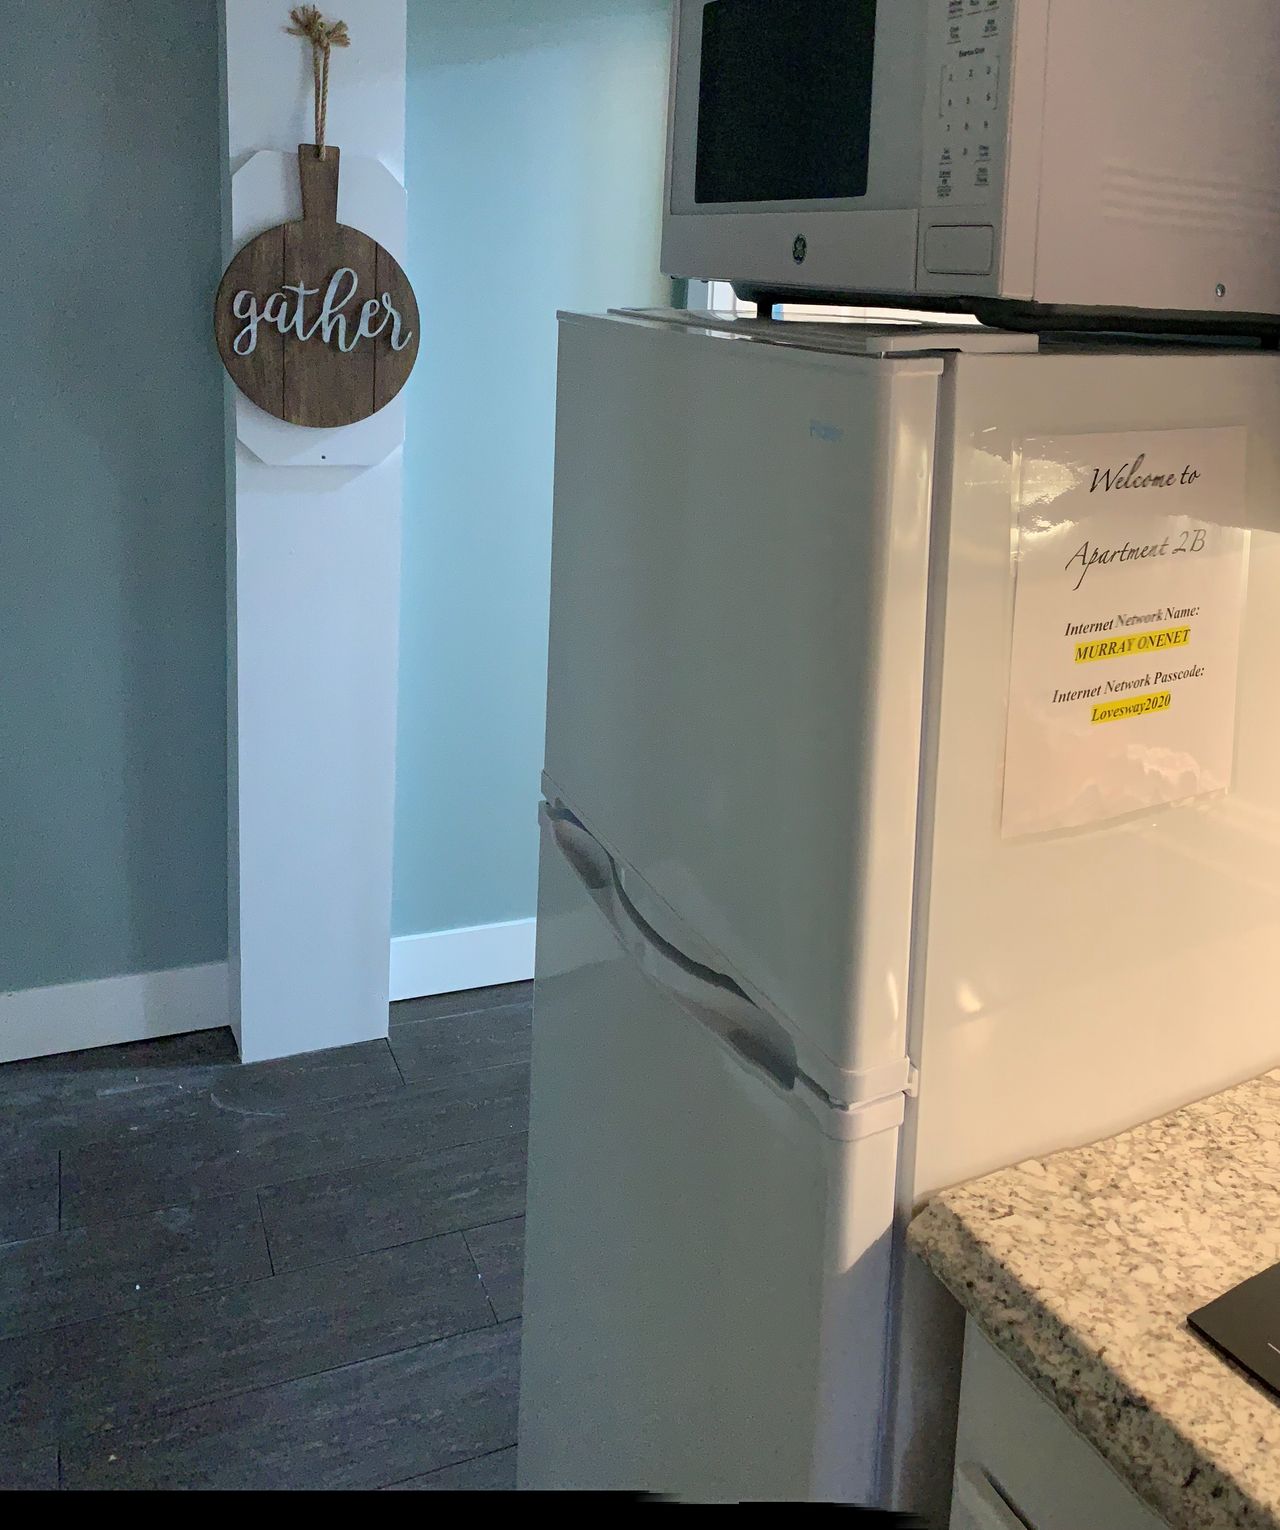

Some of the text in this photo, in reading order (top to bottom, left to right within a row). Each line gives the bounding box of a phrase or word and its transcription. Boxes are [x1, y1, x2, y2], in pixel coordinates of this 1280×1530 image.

[233, 267, 413, 356] gather
[1089, 453, 1201, 492] Welcome to
[1065, 529, 1208, 591] Apartment 2B
[1064, 606, 1201, 637] Internet Network Name:
[1075, 629, 1192, 661] MURRAY ONENET
[1051, 664, 1205, 703] Internet Network Passcode:
[1091, 693, 1172, 722] Lovesway2020
